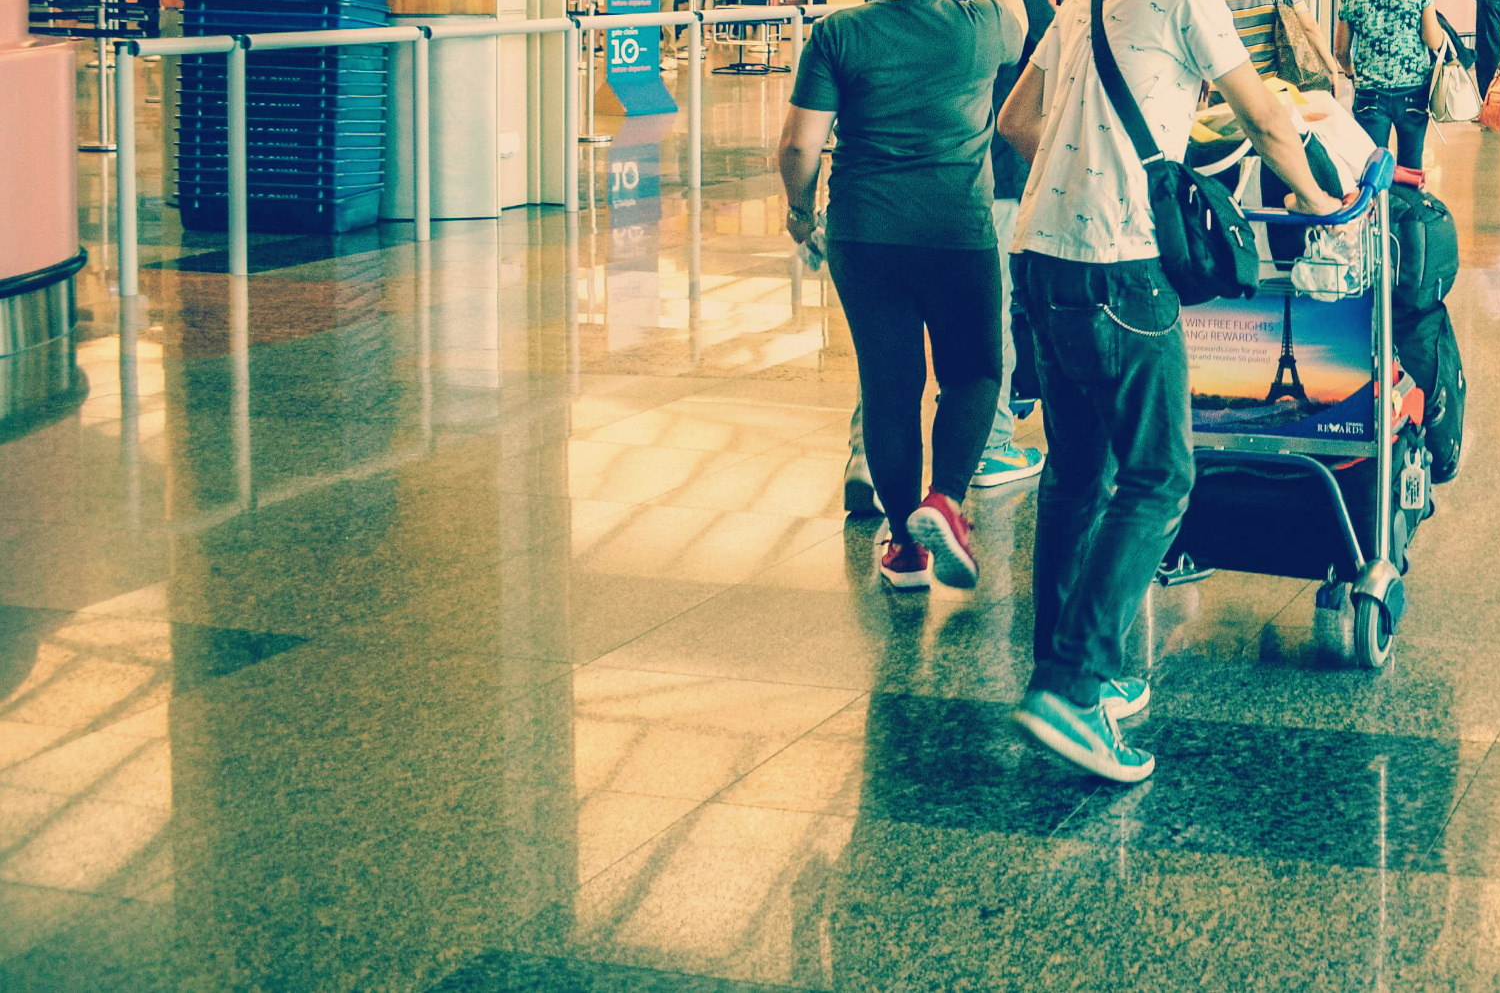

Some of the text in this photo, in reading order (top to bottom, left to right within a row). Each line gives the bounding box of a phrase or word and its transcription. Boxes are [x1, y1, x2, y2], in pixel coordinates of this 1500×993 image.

[611, 38, 639, 64] 10
[1185, 318, 1274, 332] WIN FREE FLIGHTS
[1185, 330, 1258, 343] ANGI REWARDS
[1187, 345, 1240, 354] ngirewards.com
[1241, 346, 1250, 354] for
[1213, 354, 1237, 362] receive
